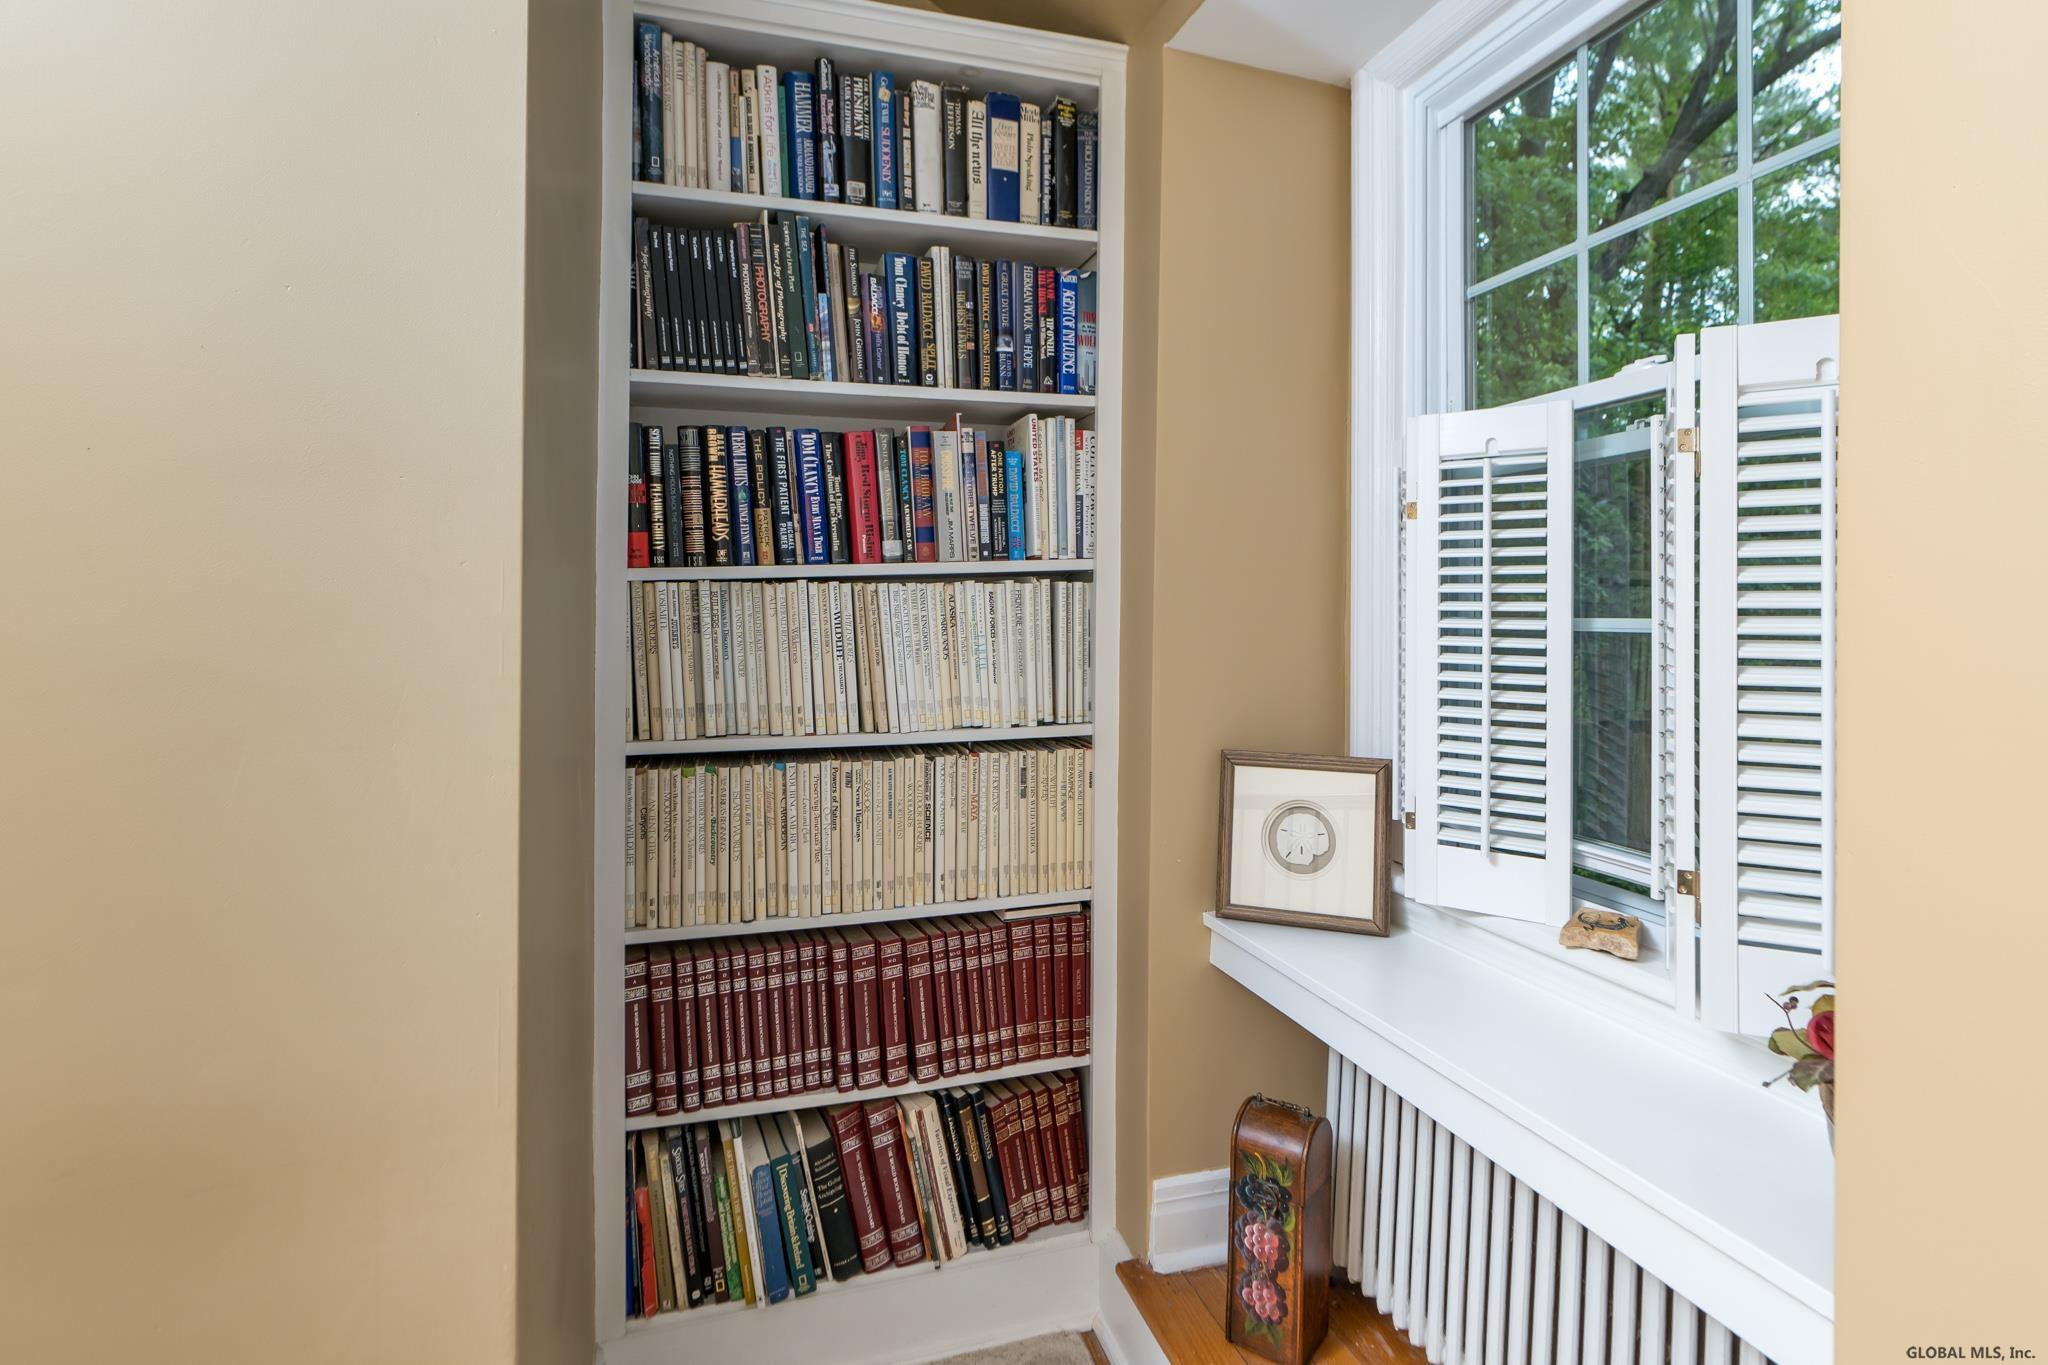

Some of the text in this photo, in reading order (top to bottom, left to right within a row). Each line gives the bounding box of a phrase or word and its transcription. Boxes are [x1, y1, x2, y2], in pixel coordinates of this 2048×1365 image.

[762, 76, 773, 113] Atkins
[795, 82, 812, 134] HAMMER
[852, 77, 864, 139] PRESIDENT
[765, 115, 774, 132] for
[946, 100, 955, 150] JEFFERSON
[766, 134, 776, 157] Life
[882, 127, 892, 184] SUDDENLY
[970, 110, 984, 184] All the news
[1025, 132, 1034, 192] Plain Speaking
[1084, 143, 1092, 213] RICHARD NIXON
[782, 221, 792, 246] Exploring
[640, 253, 654, 320] Joy Photography
[742, 264, 752, 314] PHOTOGRAPHY
[773, 266, 781, 278] Joy
[775, 280, 782, 289] of
[892, 256, 908, 308] Tom Clancy
[754, 266, 770, 344] PHOTOGRAPHY
[870, 276, 878, 315] BALDACCI
[920, 261, 934, 339] DAVID BALDACCI
[1023, 266, 1033, 331] HERMAN WOUK
[776, 290, 788, 342] Photography
[853, 318, 862, 336] JOHN
[1062, 288, 1076, 374] AGENT OF INFLUENCE
[896, 311, 910, 376] Debt of Honor
[926, 342, 936, 371] SPLIT
[982, 328, 990, 353] SAVING
[1024, 346, 1032, 369] HOPE
[1046, 317, 1054, 358] TIP O'NEILL
[648, 428, 662, 477] SCOTT TUROW
[707, 428, 718, 461] BROWN
[716, 434, 724, 457] DALE
[731, 431, 748, 487] TERM LIMITS
[802, 432, 819, 496] TOM CLANCY
[824, 442, 832, 459] The
[854, 435, 864, 463] Clancy
[860, 440, 868, 460] Tom
[754, 436, 766, 508] THE POLICY
[775, 437, 790, 516] THE FIRST PATIENT
[826, 460, 835, 494] Cardinal
[900, 449, 909, 502] TOM CLANCY
[919, 449, 931, 519] TOM BROKAW
[708, 464, 730, 542] HAMMERHEADS
[810, 496, 820, 516] EVERY
[828, 495, 836, 503] of
[834, 475, 844, 520] Tom Clancy
[860, 464, 876, 560] Red Storm Rising
[1008, 467, 1020, 532] DAVID BALDACCI
[650, 484, 665, 552] PLEADING GUILTY
[738, 504, 750, 544] VINCE FLYNN
[756, 514, 764, 544] LYNCH
[780, 522, 788, 550] PALMER
[832, 516, 840, 552] Kremlin
[903, 504, 912, 538] ARMORED
[814, 536, 824, 554] TIGER
[658, 588, 667, 632] YOSEMITE
[720, 589, 728, 621] Pathways
[948, 593, 956, 628] ALASKA
[671, 618, 679, 650] JOURNEYS
[722, 629, 730, 662] Discovery
[832, 610, 844, 661] WILDLIFE
[920, 614, 928, 652] KINGDOMS
[831, 767, 839, 794] Powers
[638, 808, 648, 840] Canyons
[709, 817, 717, 866] Backcountry
[854, 808, 862, 843] Highways
[626, 824, 634, 866] WILDLIFE
[936, 1128, 946, 1158] Varieties
[948, 1117, 961, 1162] PRESIDENTS
[980, 1114, 993, 1160] PRESIDENTS
[942, 1166, 952, 1186] Visual
[946, 1186, 958, 1224] Experience
